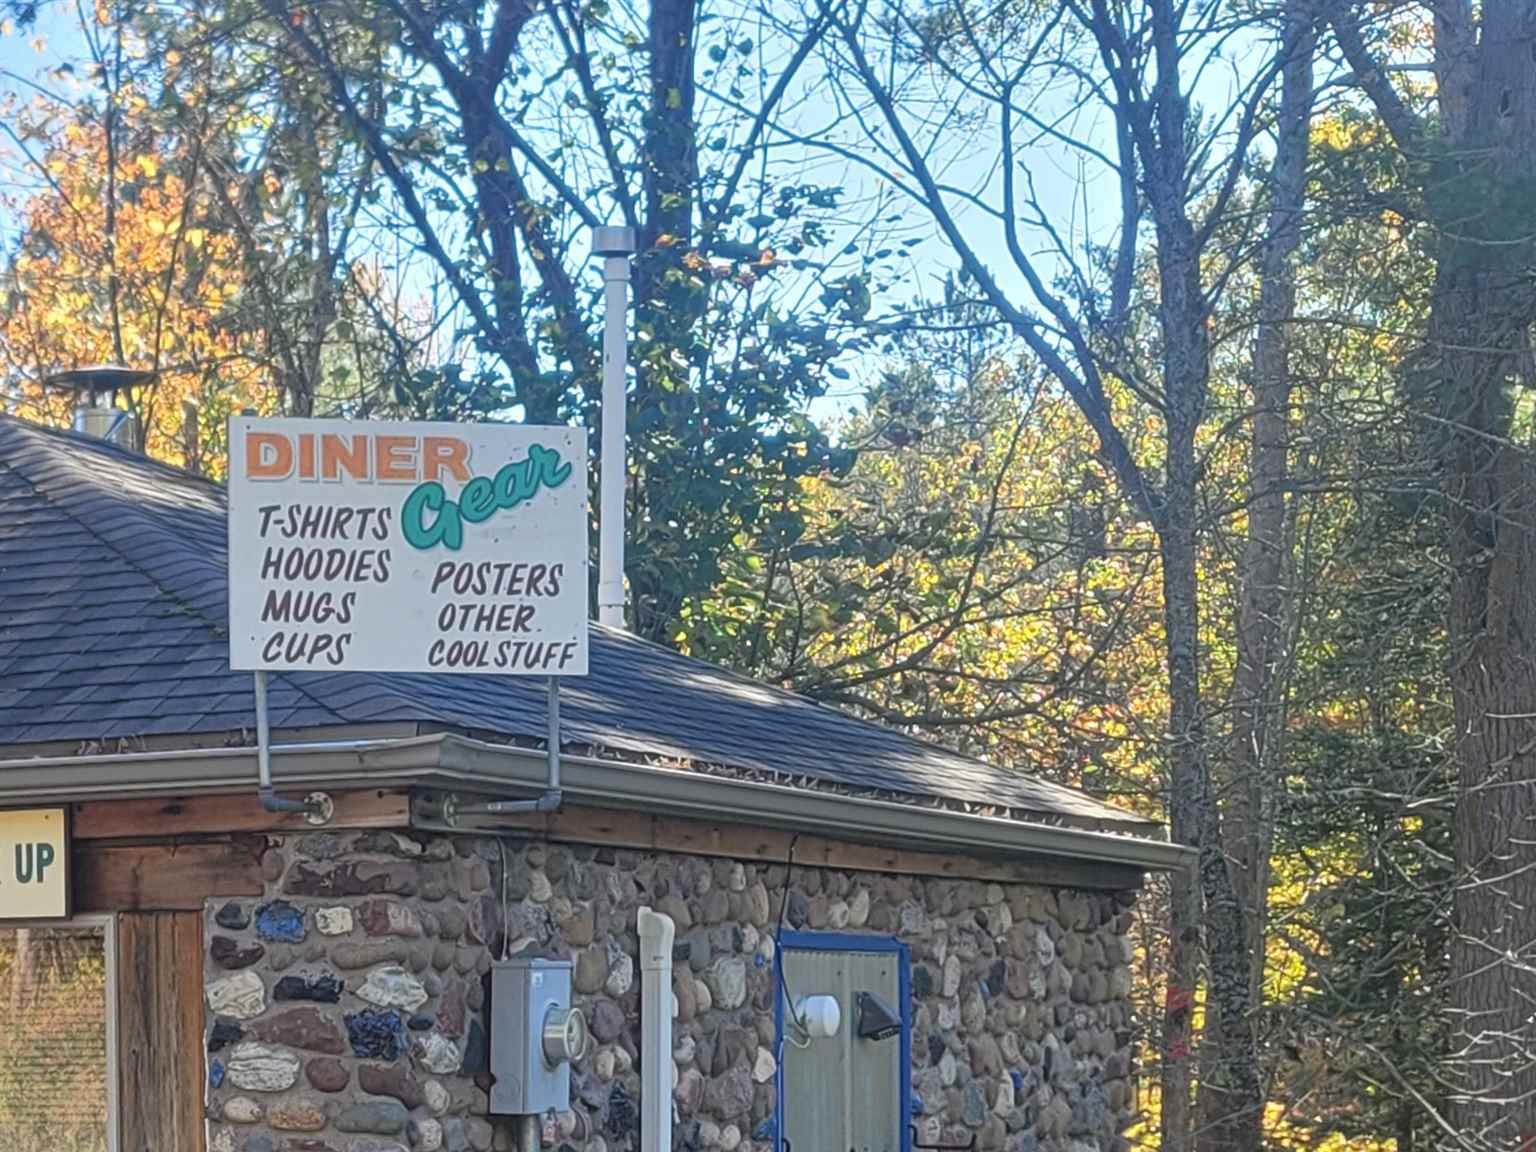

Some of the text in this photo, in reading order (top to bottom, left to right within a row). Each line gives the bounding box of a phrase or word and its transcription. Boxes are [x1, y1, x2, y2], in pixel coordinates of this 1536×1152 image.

[246, 433, 570, 549] DINER Gear
[259, 505, 392, 540] T-SHIRTS
[261, 547, 392, 582] HOODIES
[431, 562, 564, 597] POSTERS
[261, 590, 356, 623] MUGS
[438, 603, 535, 632] OTHER
[262, 631, 352, 665] CUPS
[15, 843, 55, 884] UP
